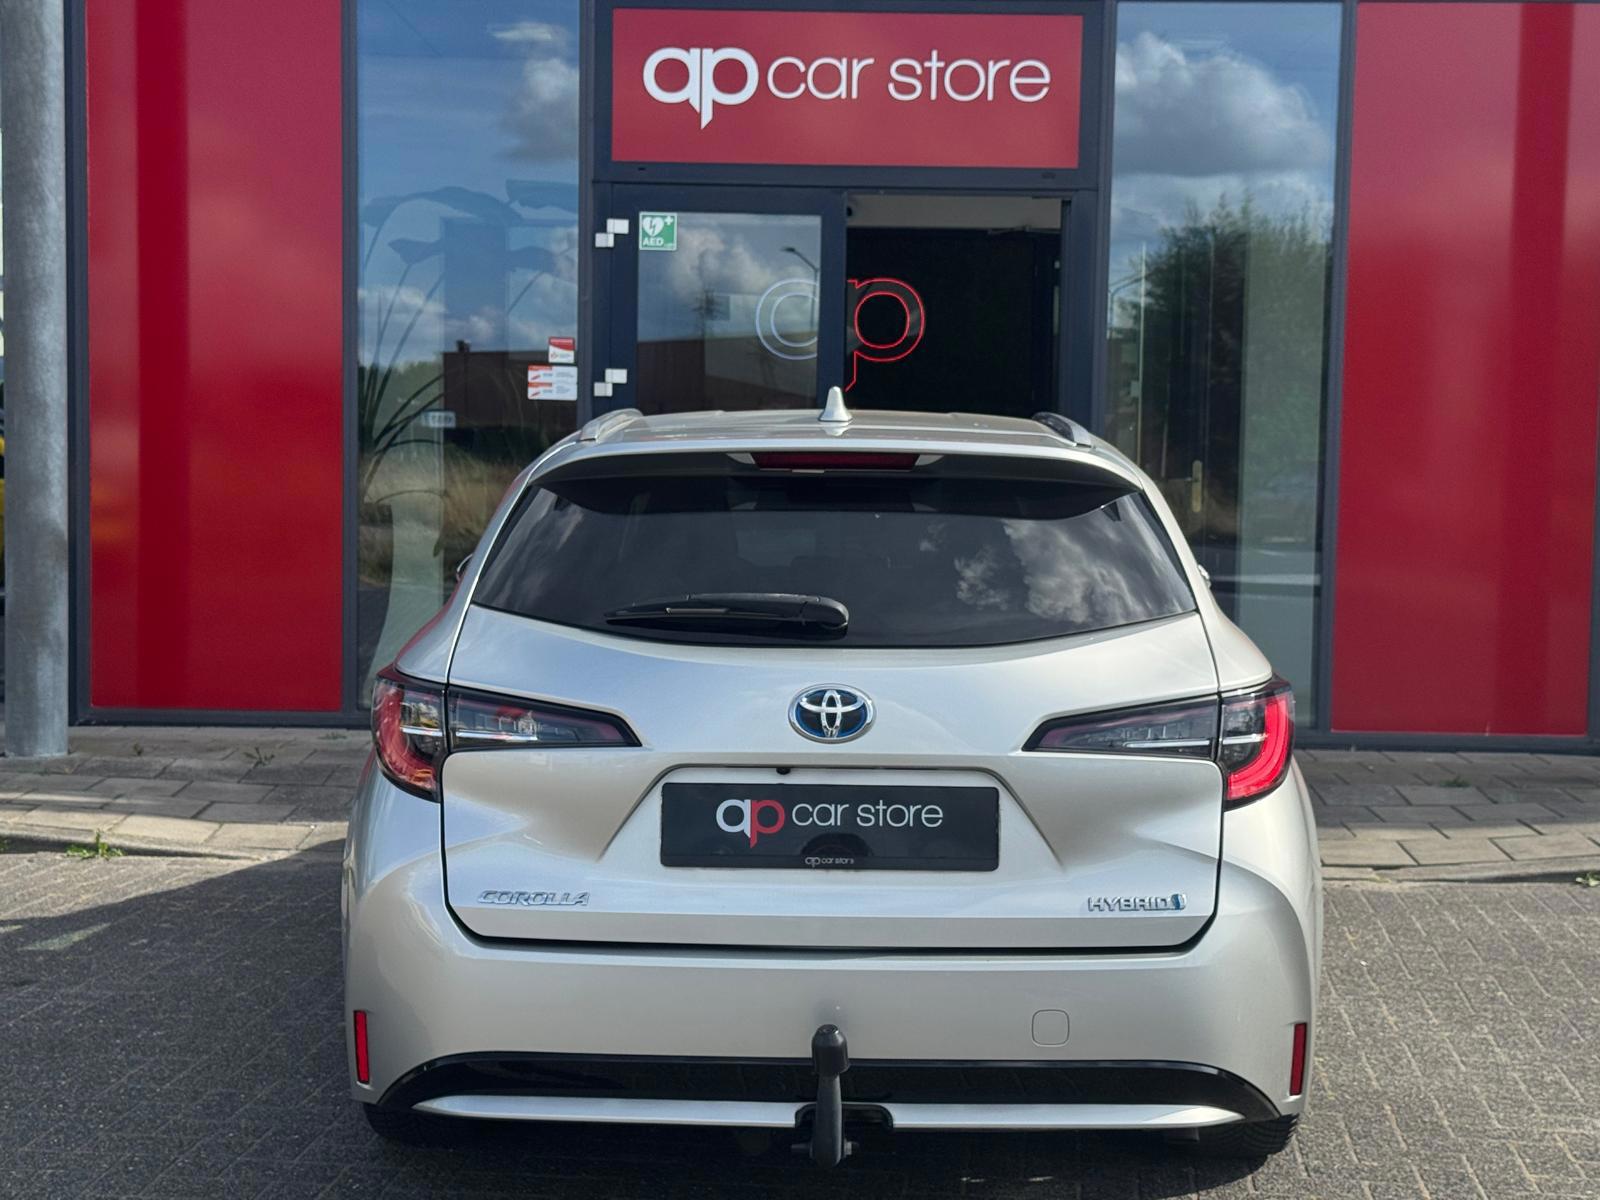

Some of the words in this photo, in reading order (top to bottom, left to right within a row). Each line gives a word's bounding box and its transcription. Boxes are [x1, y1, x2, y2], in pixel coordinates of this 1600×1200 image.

[767, 56, 874, 100] car
[887, 49, 1051, 103] store
[643, 237, 664, 247] AED
[791, 803, 850, 827] car
[856, 799, 944, 828] store
[478, 890, 589, 906] COROLLA
[1087, 896, 1171, 912] HYBRID
